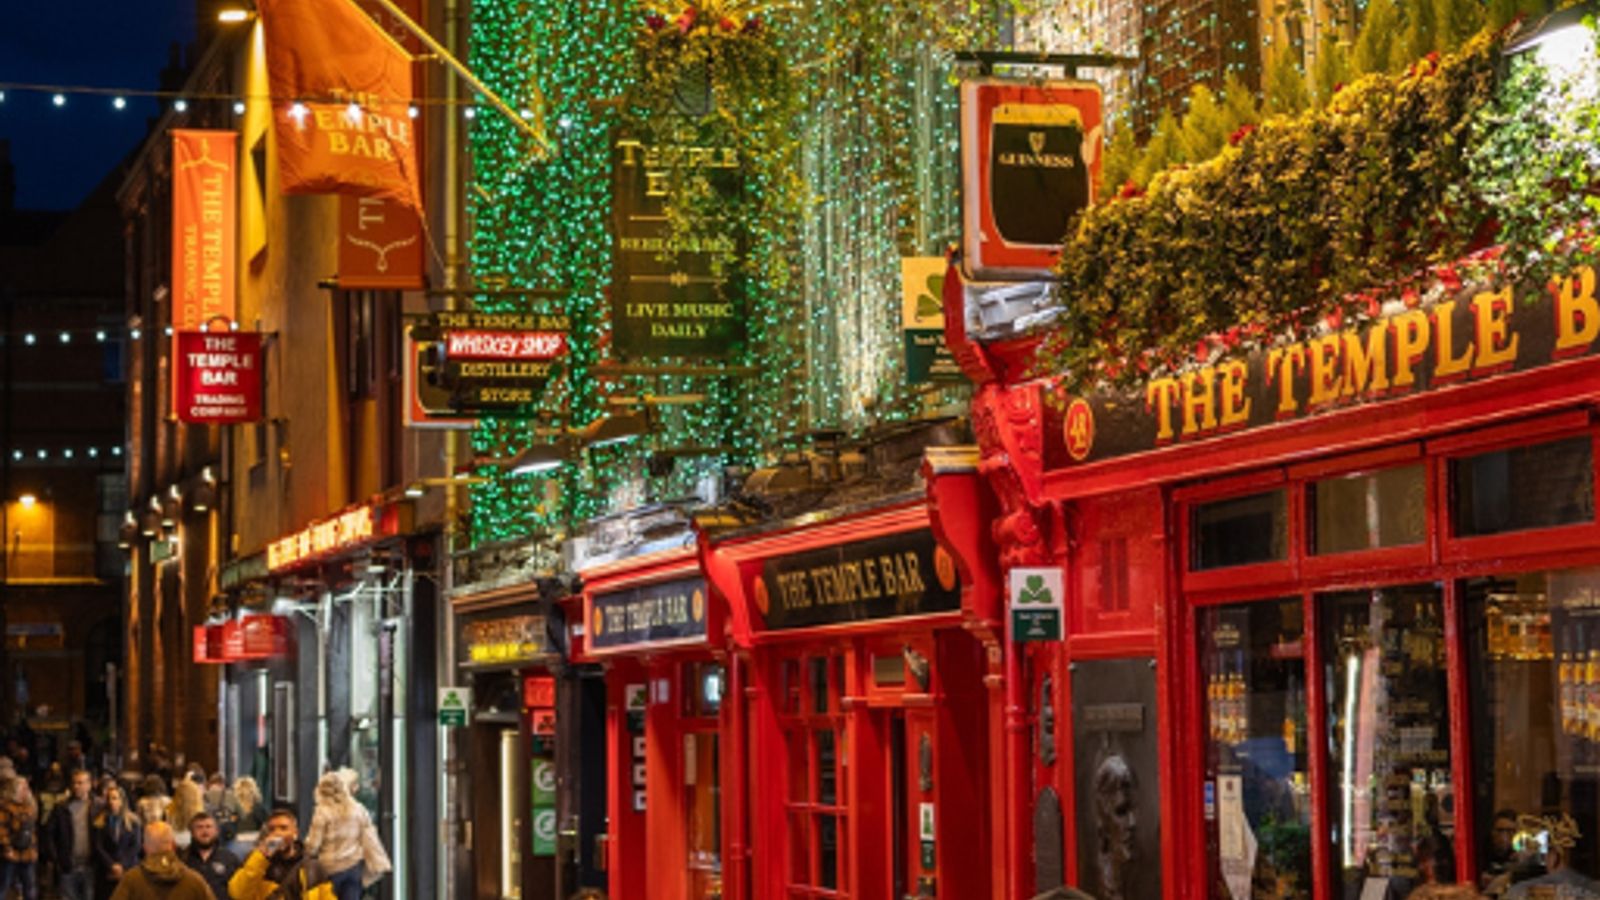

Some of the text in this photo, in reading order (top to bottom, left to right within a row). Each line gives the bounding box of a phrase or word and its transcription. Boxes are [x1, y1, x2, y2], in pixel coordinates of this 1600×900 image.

[328, 88, 381, 111] THE
[329, 132, 396, 161] BAR
[998, 153, 1076, 168] GUINNESS
[202, 173, 223, 224] THE
[626, 303, 734, 318] LIVE MUSIC
[438, 313, 570, 329] THE TEMPLE BAR
[652, 323, 709, 338] DAILY
[204, 337, 237, 351] THE
[450, 333, 562, 355] WHISKEY SHOP
[187, 353, 254, 369] TEMPLE
[1147, 360, 1251, 440] THE
[1266, 285, 1519, 414] TEMPLE
[201, 369, 238, 386] BAR
[461, 363, 549, 377] DISTILLERY
[480, 387, 532, 402] STORE
[776, 551, 925, 609] THE TEMPLE BAR
